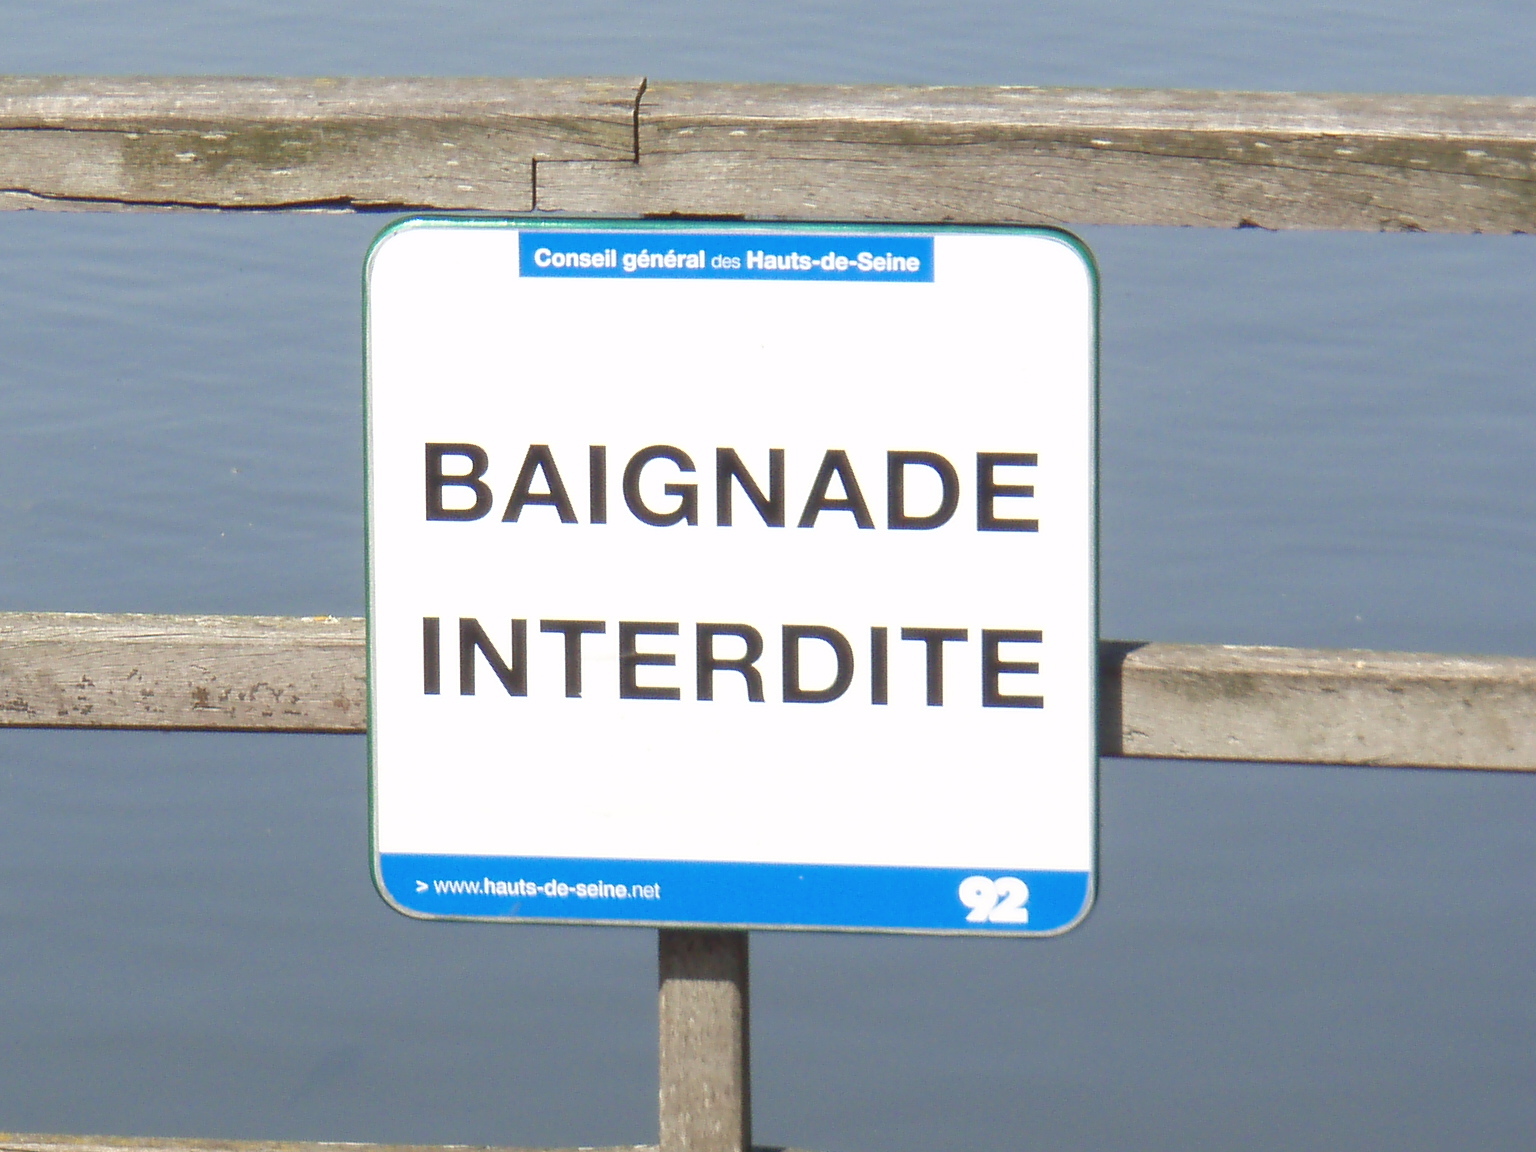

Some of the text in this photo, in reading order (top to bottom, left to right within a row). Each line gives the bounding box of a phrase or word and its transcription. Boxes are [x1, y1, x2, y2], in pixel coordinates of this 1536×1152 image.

[533, 247, 921, 274] Conseil général des Hauts-de-Seine
[425, 442, 1039, 533] BAIGNADE
[423, 617, 1044, 708] INTERDITE
[433, 877, 662, 899] www.hauts-de-seine.net
[958, 875, 1030, 924] 92
